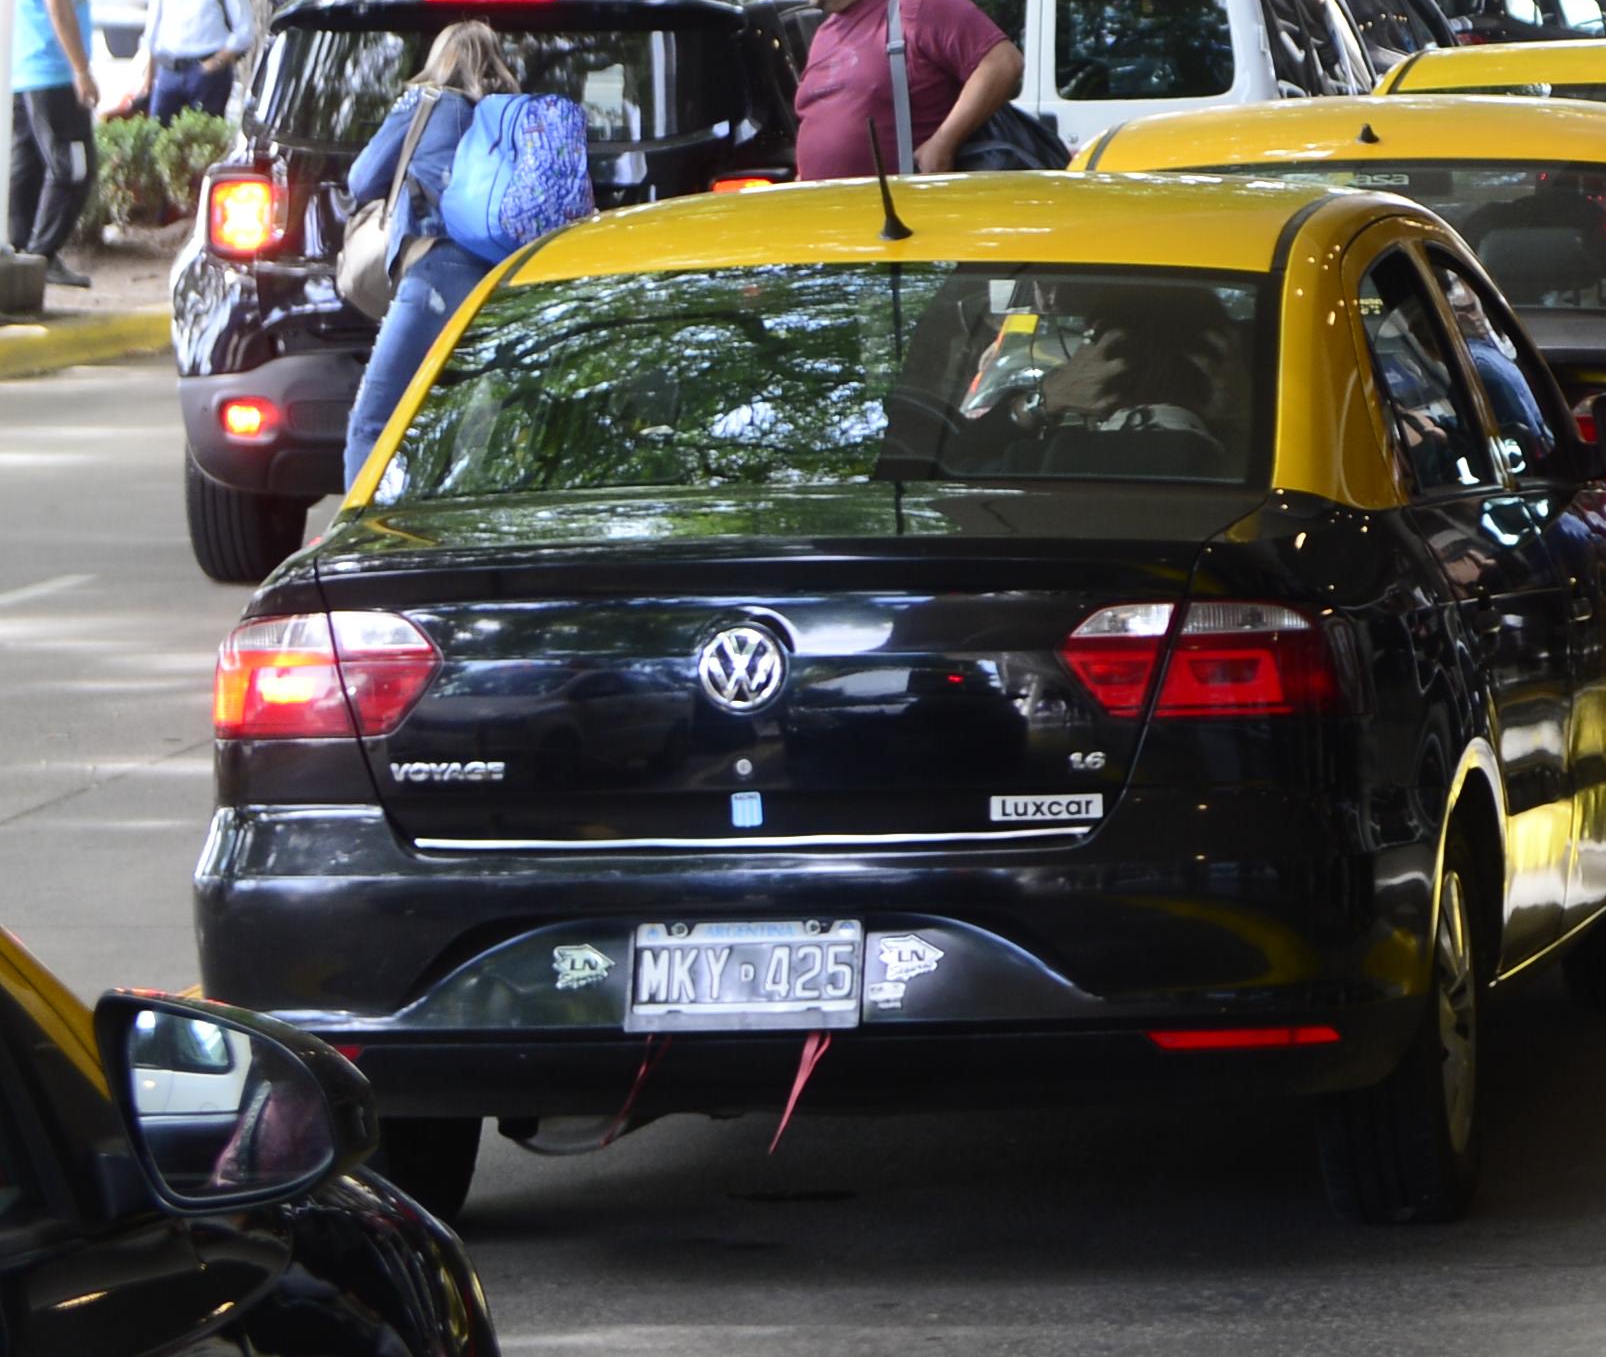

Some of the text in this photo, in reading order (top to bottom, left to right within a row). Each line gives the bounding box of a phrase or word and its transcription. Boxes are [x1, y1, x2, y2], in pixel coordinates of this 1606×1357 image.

[390, 761, 506, 782] VOYAGE
[1001, 798, 1094, 817] Luxcar
[703, 921, 796, 939] ARGENTINA
[898, 948, 926, 962] LN
[569, 958, 598, 971] LN
[639, 946, 731, 1002] MKY
[764, 944, 855, 998] 425
